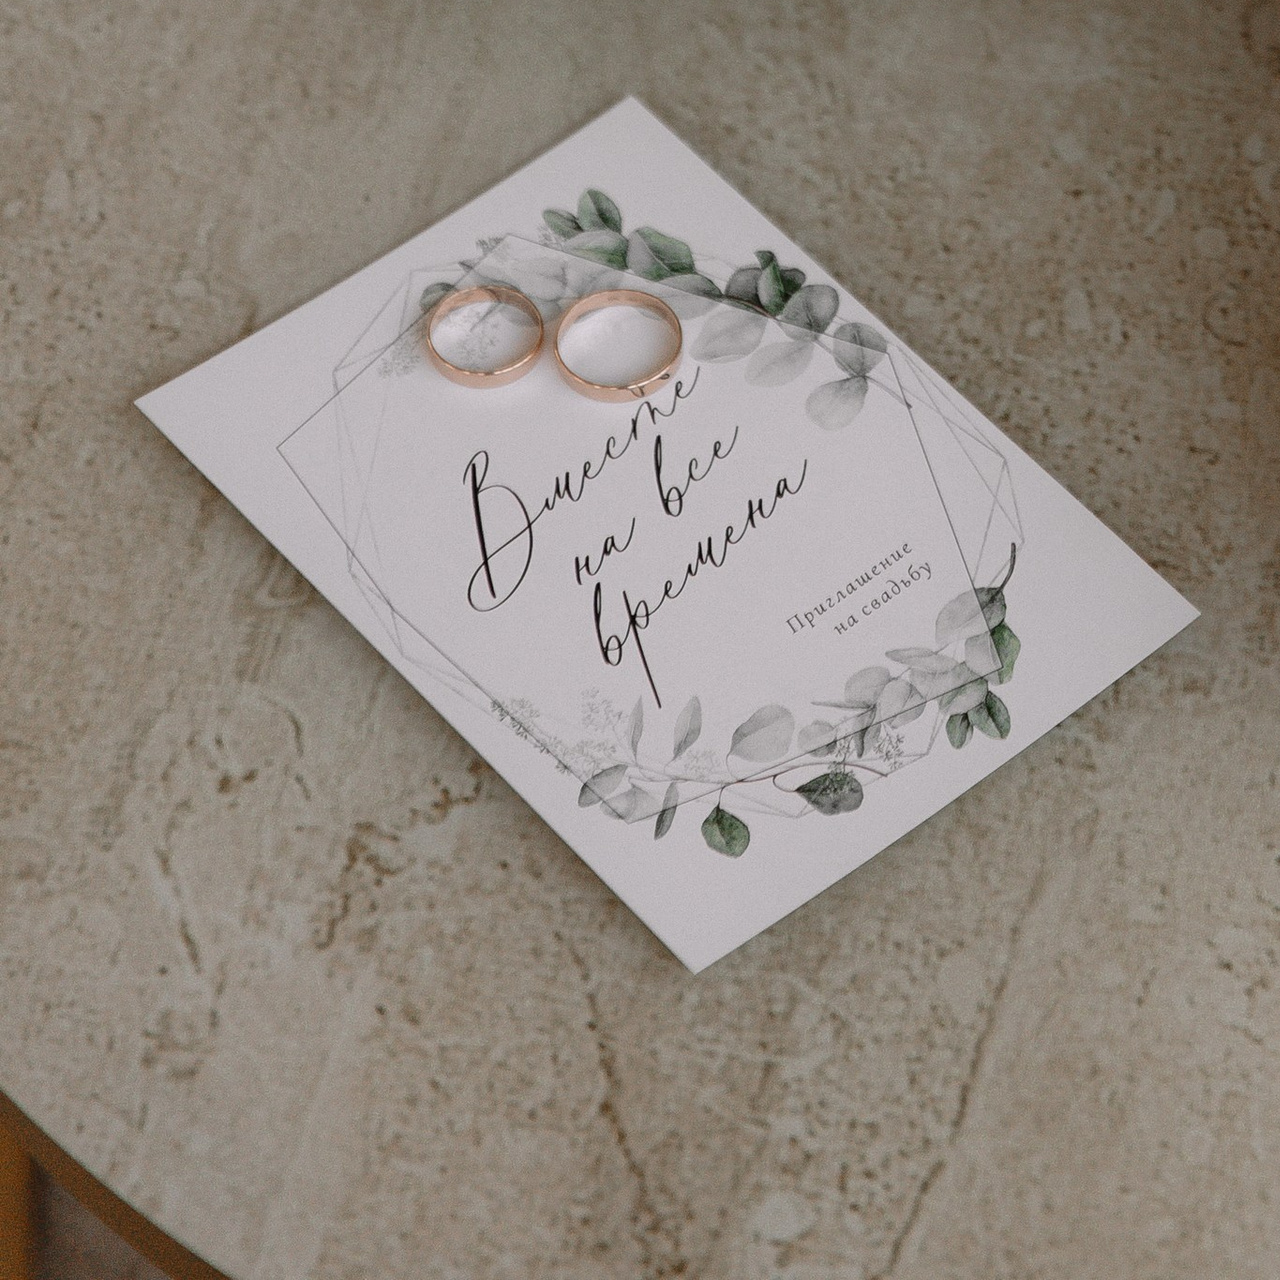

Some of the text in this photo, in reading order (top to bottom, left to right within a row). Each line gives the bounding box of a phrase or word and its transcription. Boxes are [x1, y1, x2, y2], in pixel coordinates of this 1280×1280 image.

[462, 365, 700, 613] Вместе
[574, 424, 739, 586] на все
[593, 458, 808, 710] времена
[785, 543, 913, 634] Приглашение
[833, 561, 932, 635] на свадьбу
